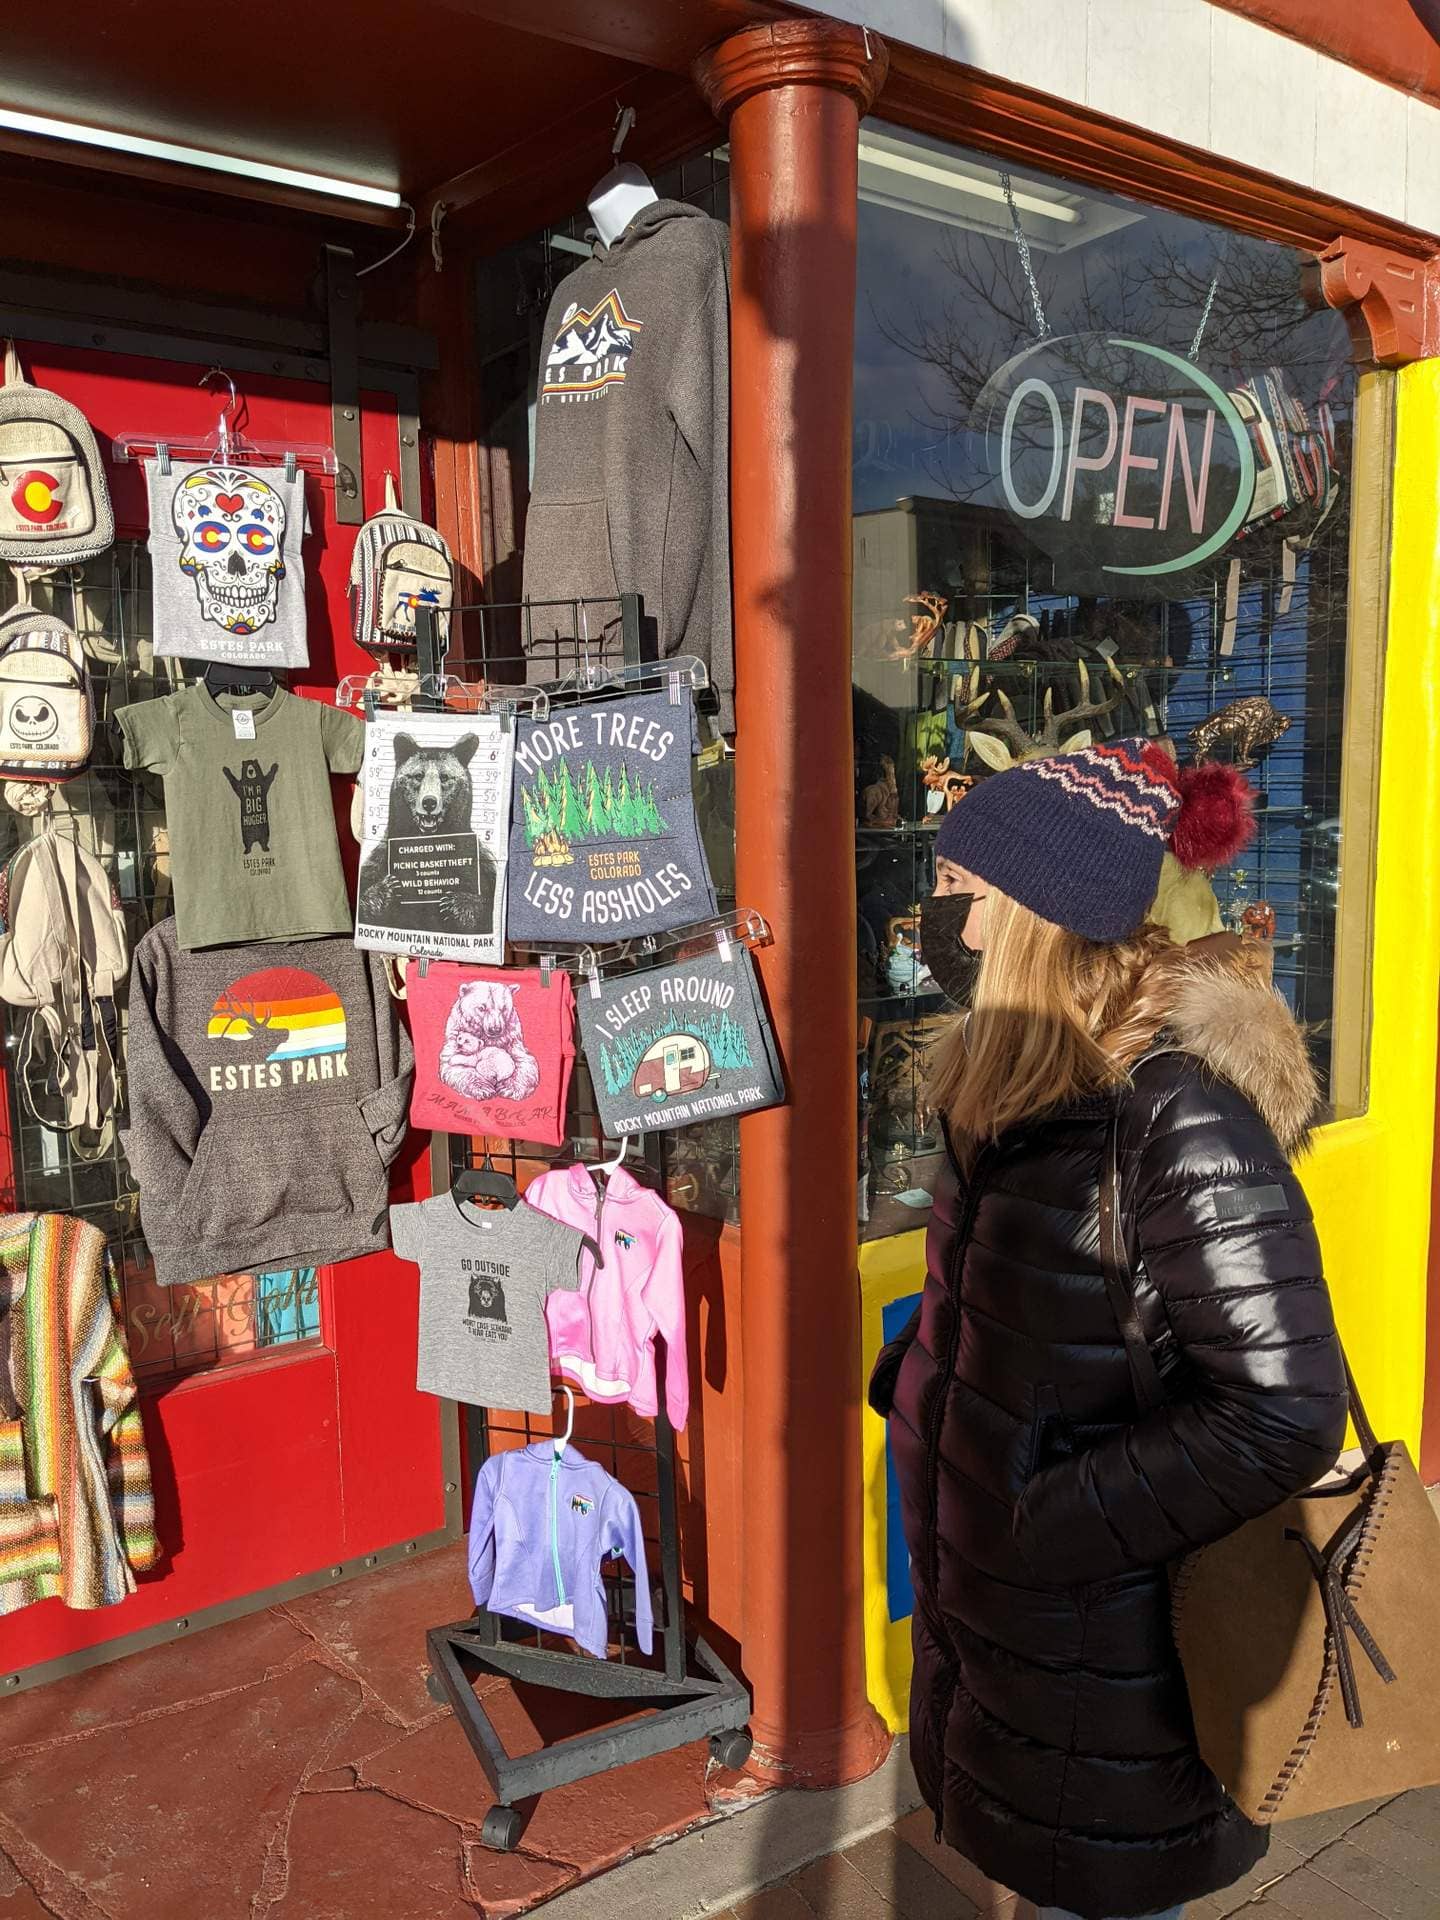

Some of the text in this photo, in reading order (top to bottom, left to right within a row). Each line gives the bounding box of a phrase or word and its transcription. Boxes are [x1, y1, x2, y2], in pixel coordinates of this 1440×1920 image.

[1001, 378, 1216, 534] OPEN
[200, 639, 284, 652] ESTES PARK
[221, 651, 266, 660] COLORADO
[514, 712, 674, 775] MORE TREES
[372, 747, 499, 760] 6' 6'
[246, 796, 262, 813] BIG
[243, 813, 267, 826] HUGGER
[372, 825, 494, 840] 5' 5'
[398, 843, 456, 854] CHARGED WITH:
[243, 858, 260, 869] ESTES
[393, 858, 473, 870] PICNIC BASKET THEFT
[588, 850, 641, 867] ESTES PARK
[590, 864, 642, 881] COLORADO
[401, 877, 460, 888] WILD BEHAVIOR
[523, 862, 692, 924] LESS ASSHOLES
[358, 927, 495, 948] ROCKY MOUNTAIN NATIONAL PARK
[409, 945, 444, 957] Colorado
[595, 976, 735, 1040] I SLEEP AROUND
[210, 1052, 349, 1092] ESTES PARK
[613, 1086, 764, 1134] ROCKY MOUNTAIN NATIONAL PARK
[461, 1258, 511, 1278] GO OUTSIDE
